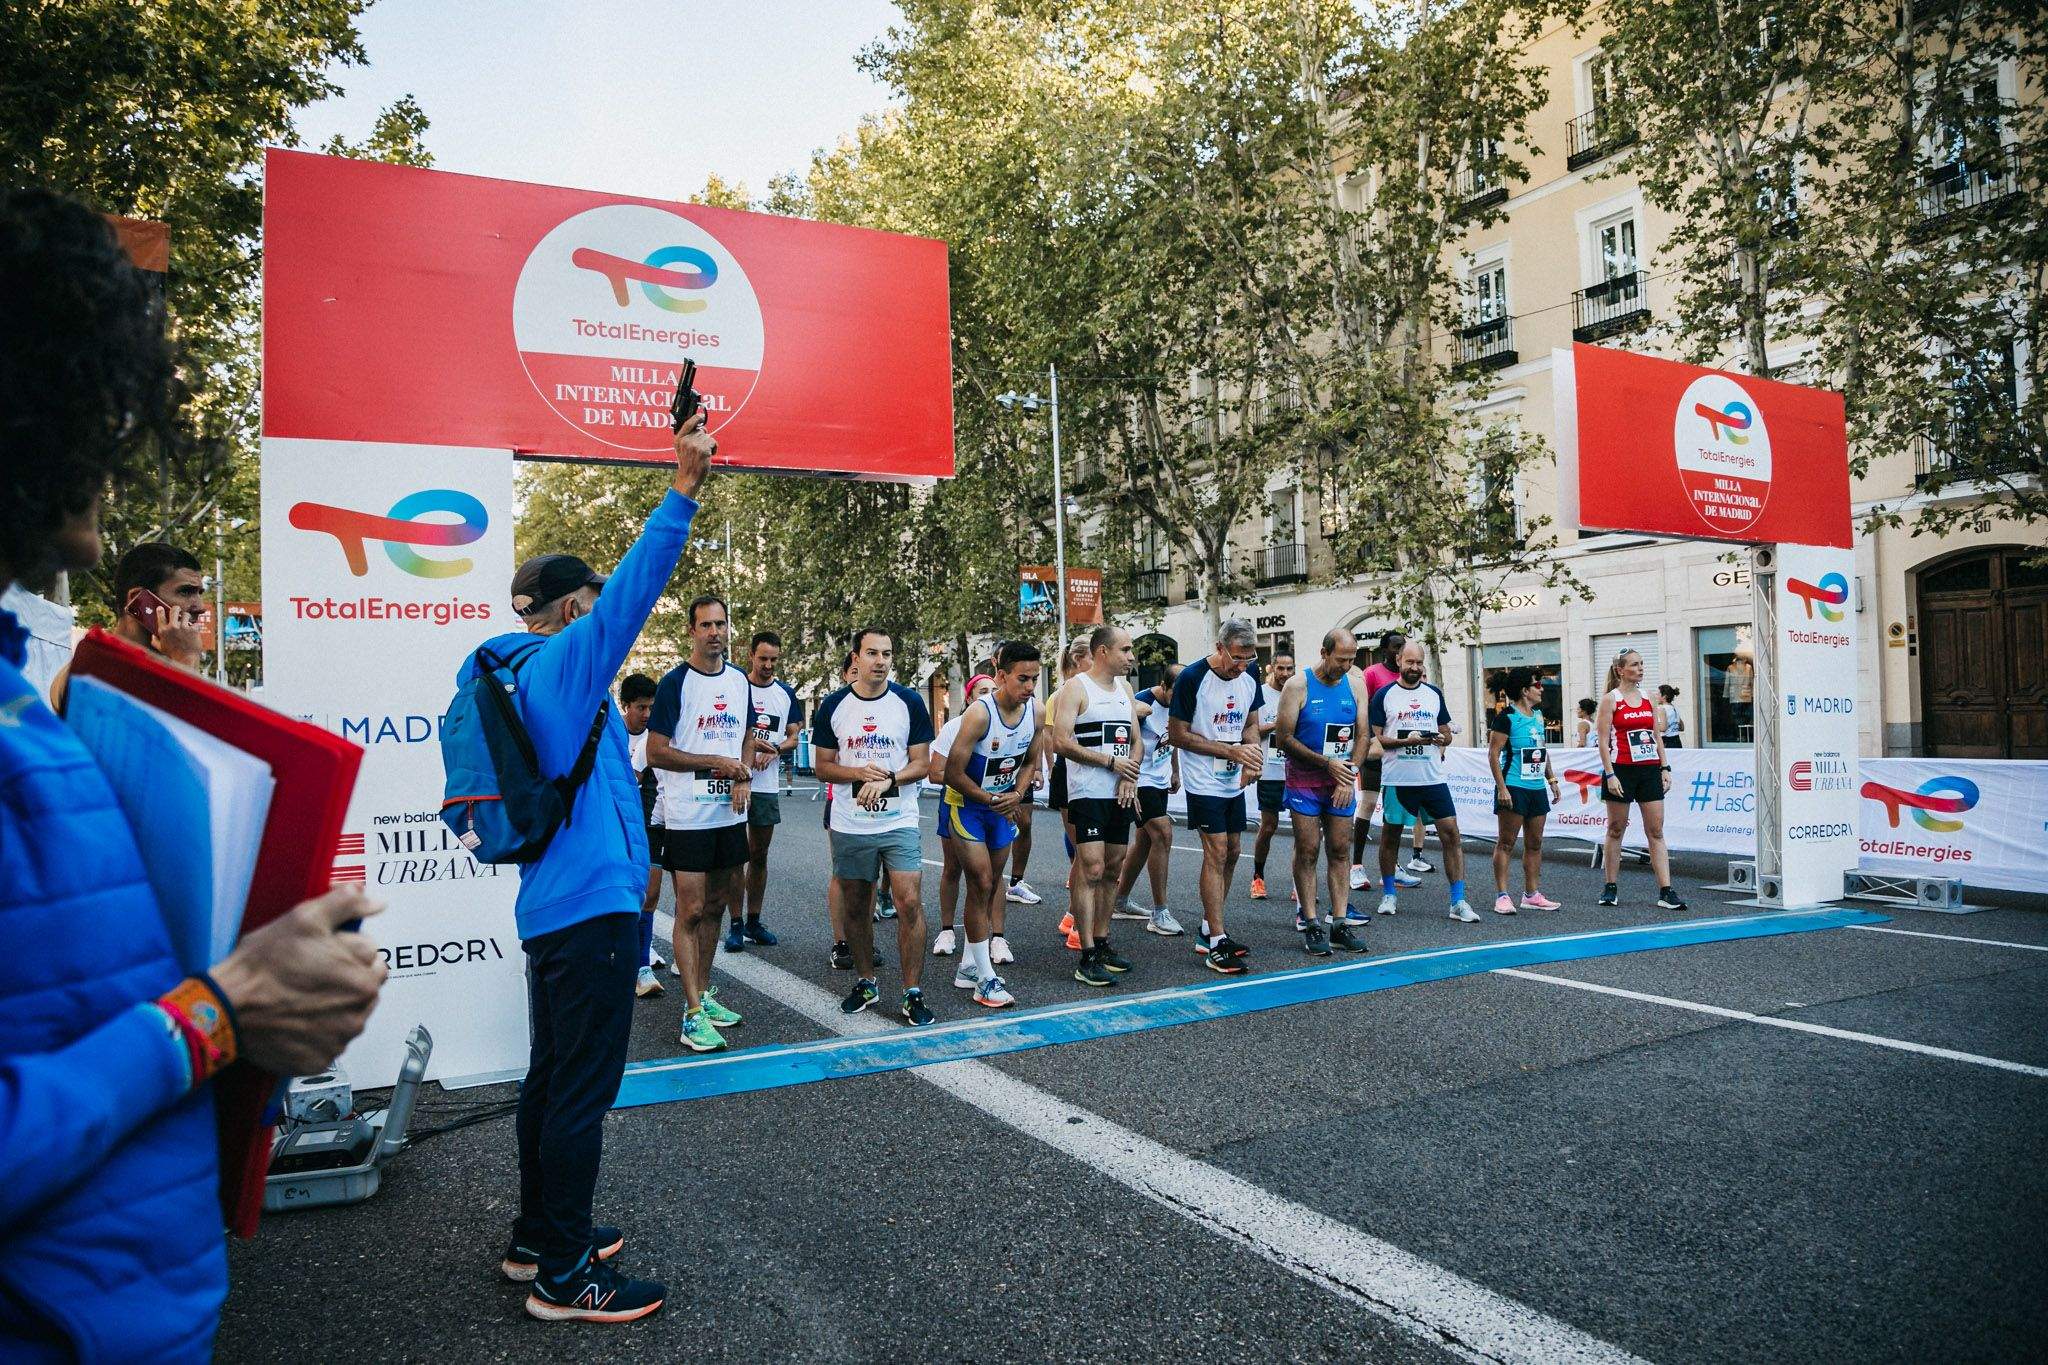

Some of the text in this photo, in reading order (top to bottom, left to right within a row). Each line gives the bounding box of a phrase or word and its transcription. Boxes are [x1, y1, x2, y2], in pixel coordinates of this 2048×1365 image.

[572, 319, 720, 348] TotalEnergies
[611, 366, 679, 387] MILLA
[556, 383, 731, 412] INTERNACIaL
[584, 408, 615, 425] DE
[1698, 448, 1755, 468] TotalEnergies
[1714, 478, 1742, 492] MILLA
[1705, 504, 1752, 521] DE MADRID
[1974, 519, 1991, 533] 30
[1022, 572, 1038, 580] ISLA
[289, 597, 491, 626] TotalEnergies
[1257, 615, 1285, 629] KORS
[1788, 630, 1850, 648] TotalEnergies
[1804, 697, 1853, 713] MADRID
[1405, 745, 1424, 755] 558
[1815, 761, 1848, 774] MILLA
[707, 780, 731, 794] 565
[373, 815, 400, 825] new
